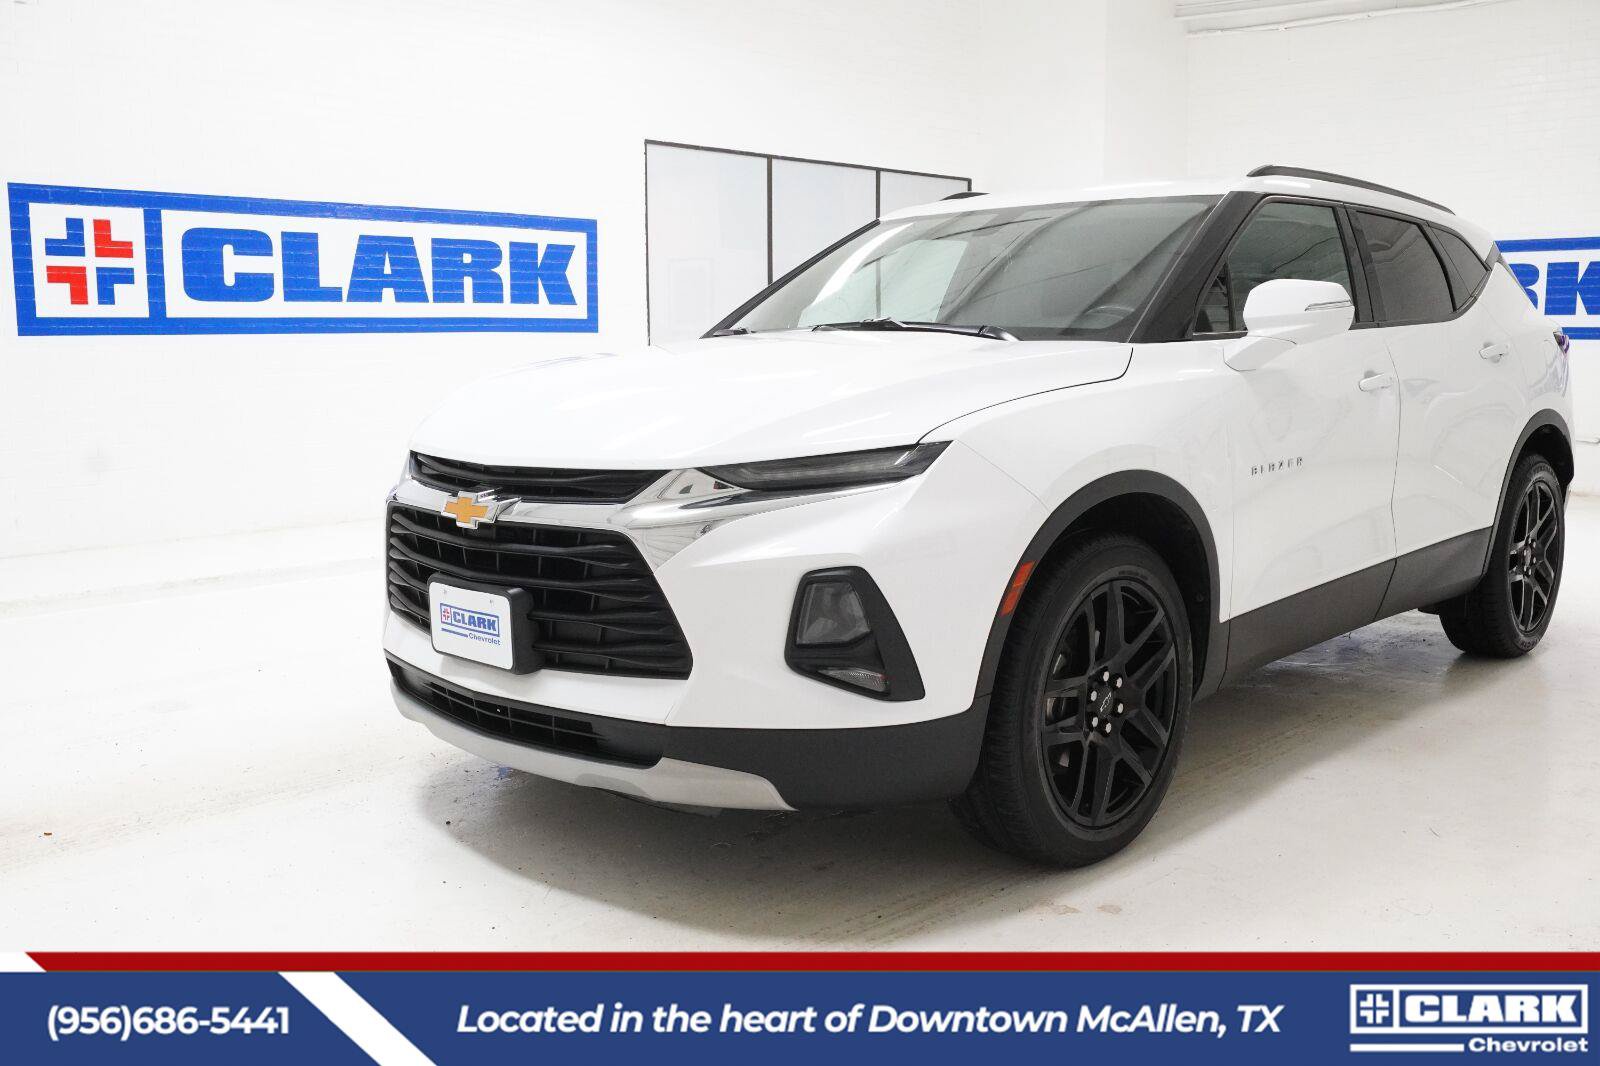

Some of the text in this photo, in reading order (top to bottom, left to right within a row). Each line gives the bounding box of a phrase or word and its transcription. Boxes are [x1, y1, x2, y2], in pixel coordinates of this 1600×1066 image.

[181, 227, 576, 306] CLARK
[1508, 261, 1600, 316] K
[452, 610, 497, 632] CLARK
[468, 632, 501, 645] Chevrolet
